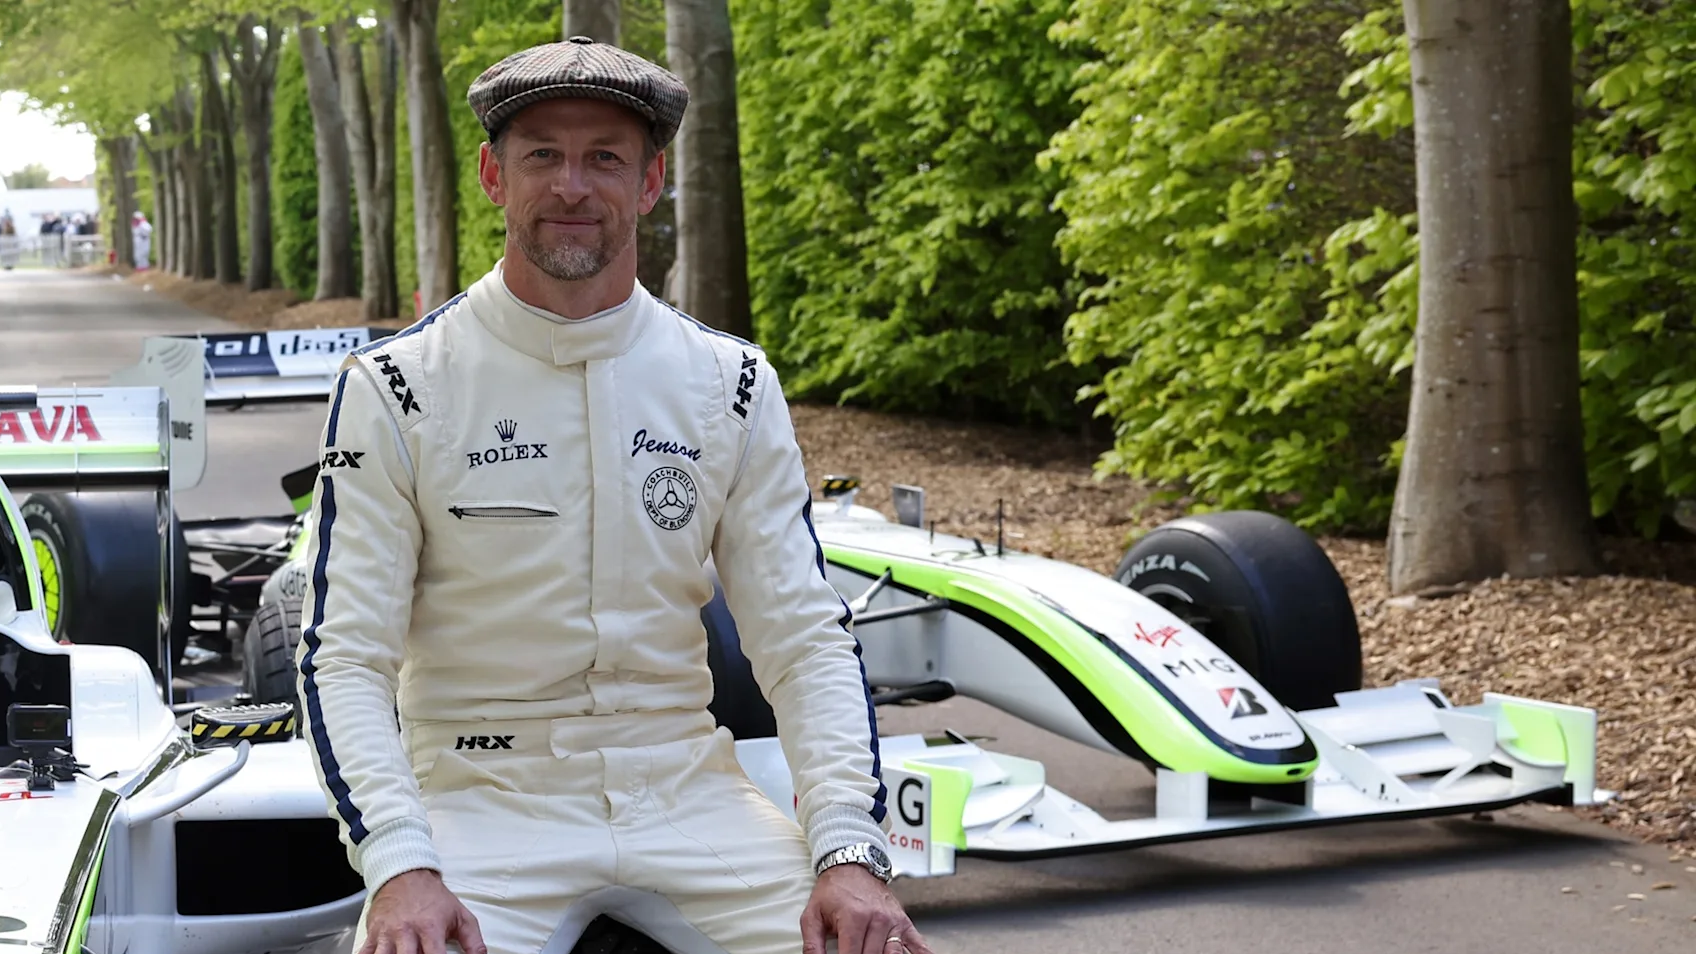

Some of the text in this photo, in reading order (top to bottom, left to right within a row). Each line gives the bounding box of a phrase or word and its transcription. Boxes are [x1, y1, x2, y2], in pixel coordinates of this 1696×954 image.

[373, 354, 422, 416] HRX
[733, 350, 757, 419] HRX
[467, 444, 548, 468] ROLEX
[632, 429, 701, 461] Jenson
[647, 469, 694, 493] COACHBUILT
[659, 519, 668, 527] OF
[669, 503, 694, 529] BLENDING
[1120, 554, 1177, 587] ENZA
[1162, 657, 1237, 678] MIG
[455, 735, 516, 750] HRX
